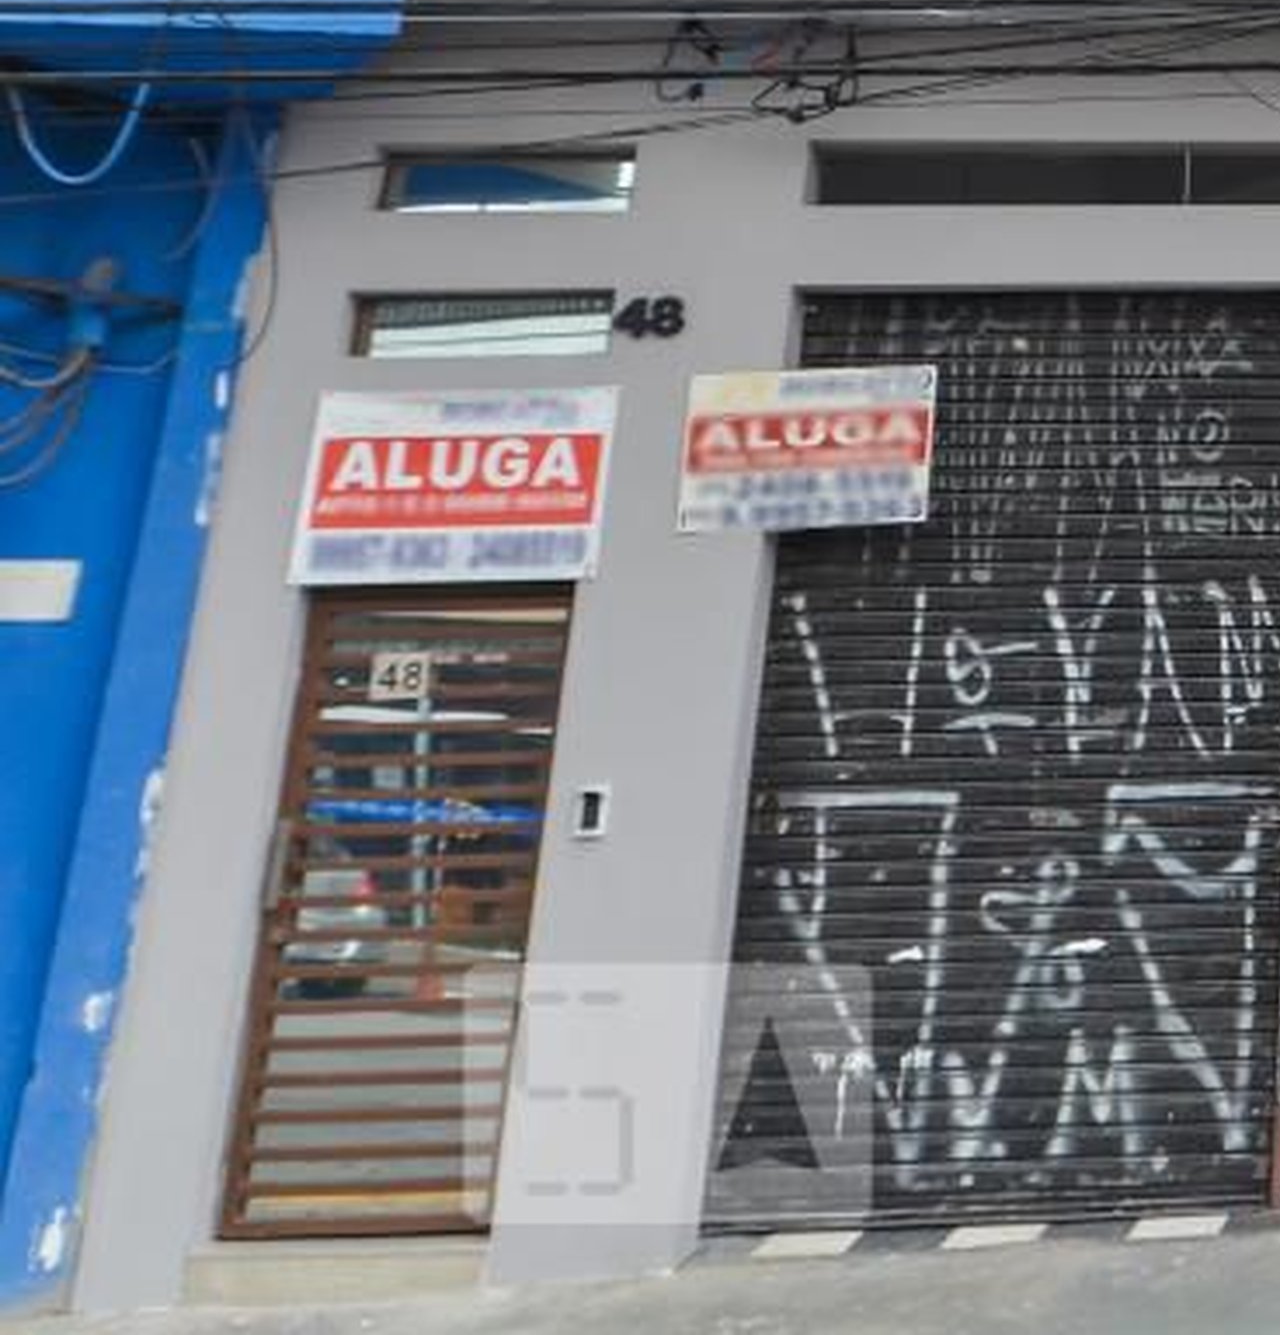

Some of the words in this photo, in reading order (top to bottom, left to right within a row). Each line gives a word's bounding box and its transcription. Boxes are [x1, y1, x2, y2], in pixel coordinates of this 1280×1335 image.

[612, 295, 685, 341] 48
[692, 410, 922, 449] ALUGA
[329, 437, 583, 489] ALUGA
[377, 662, 422, 691] 48
